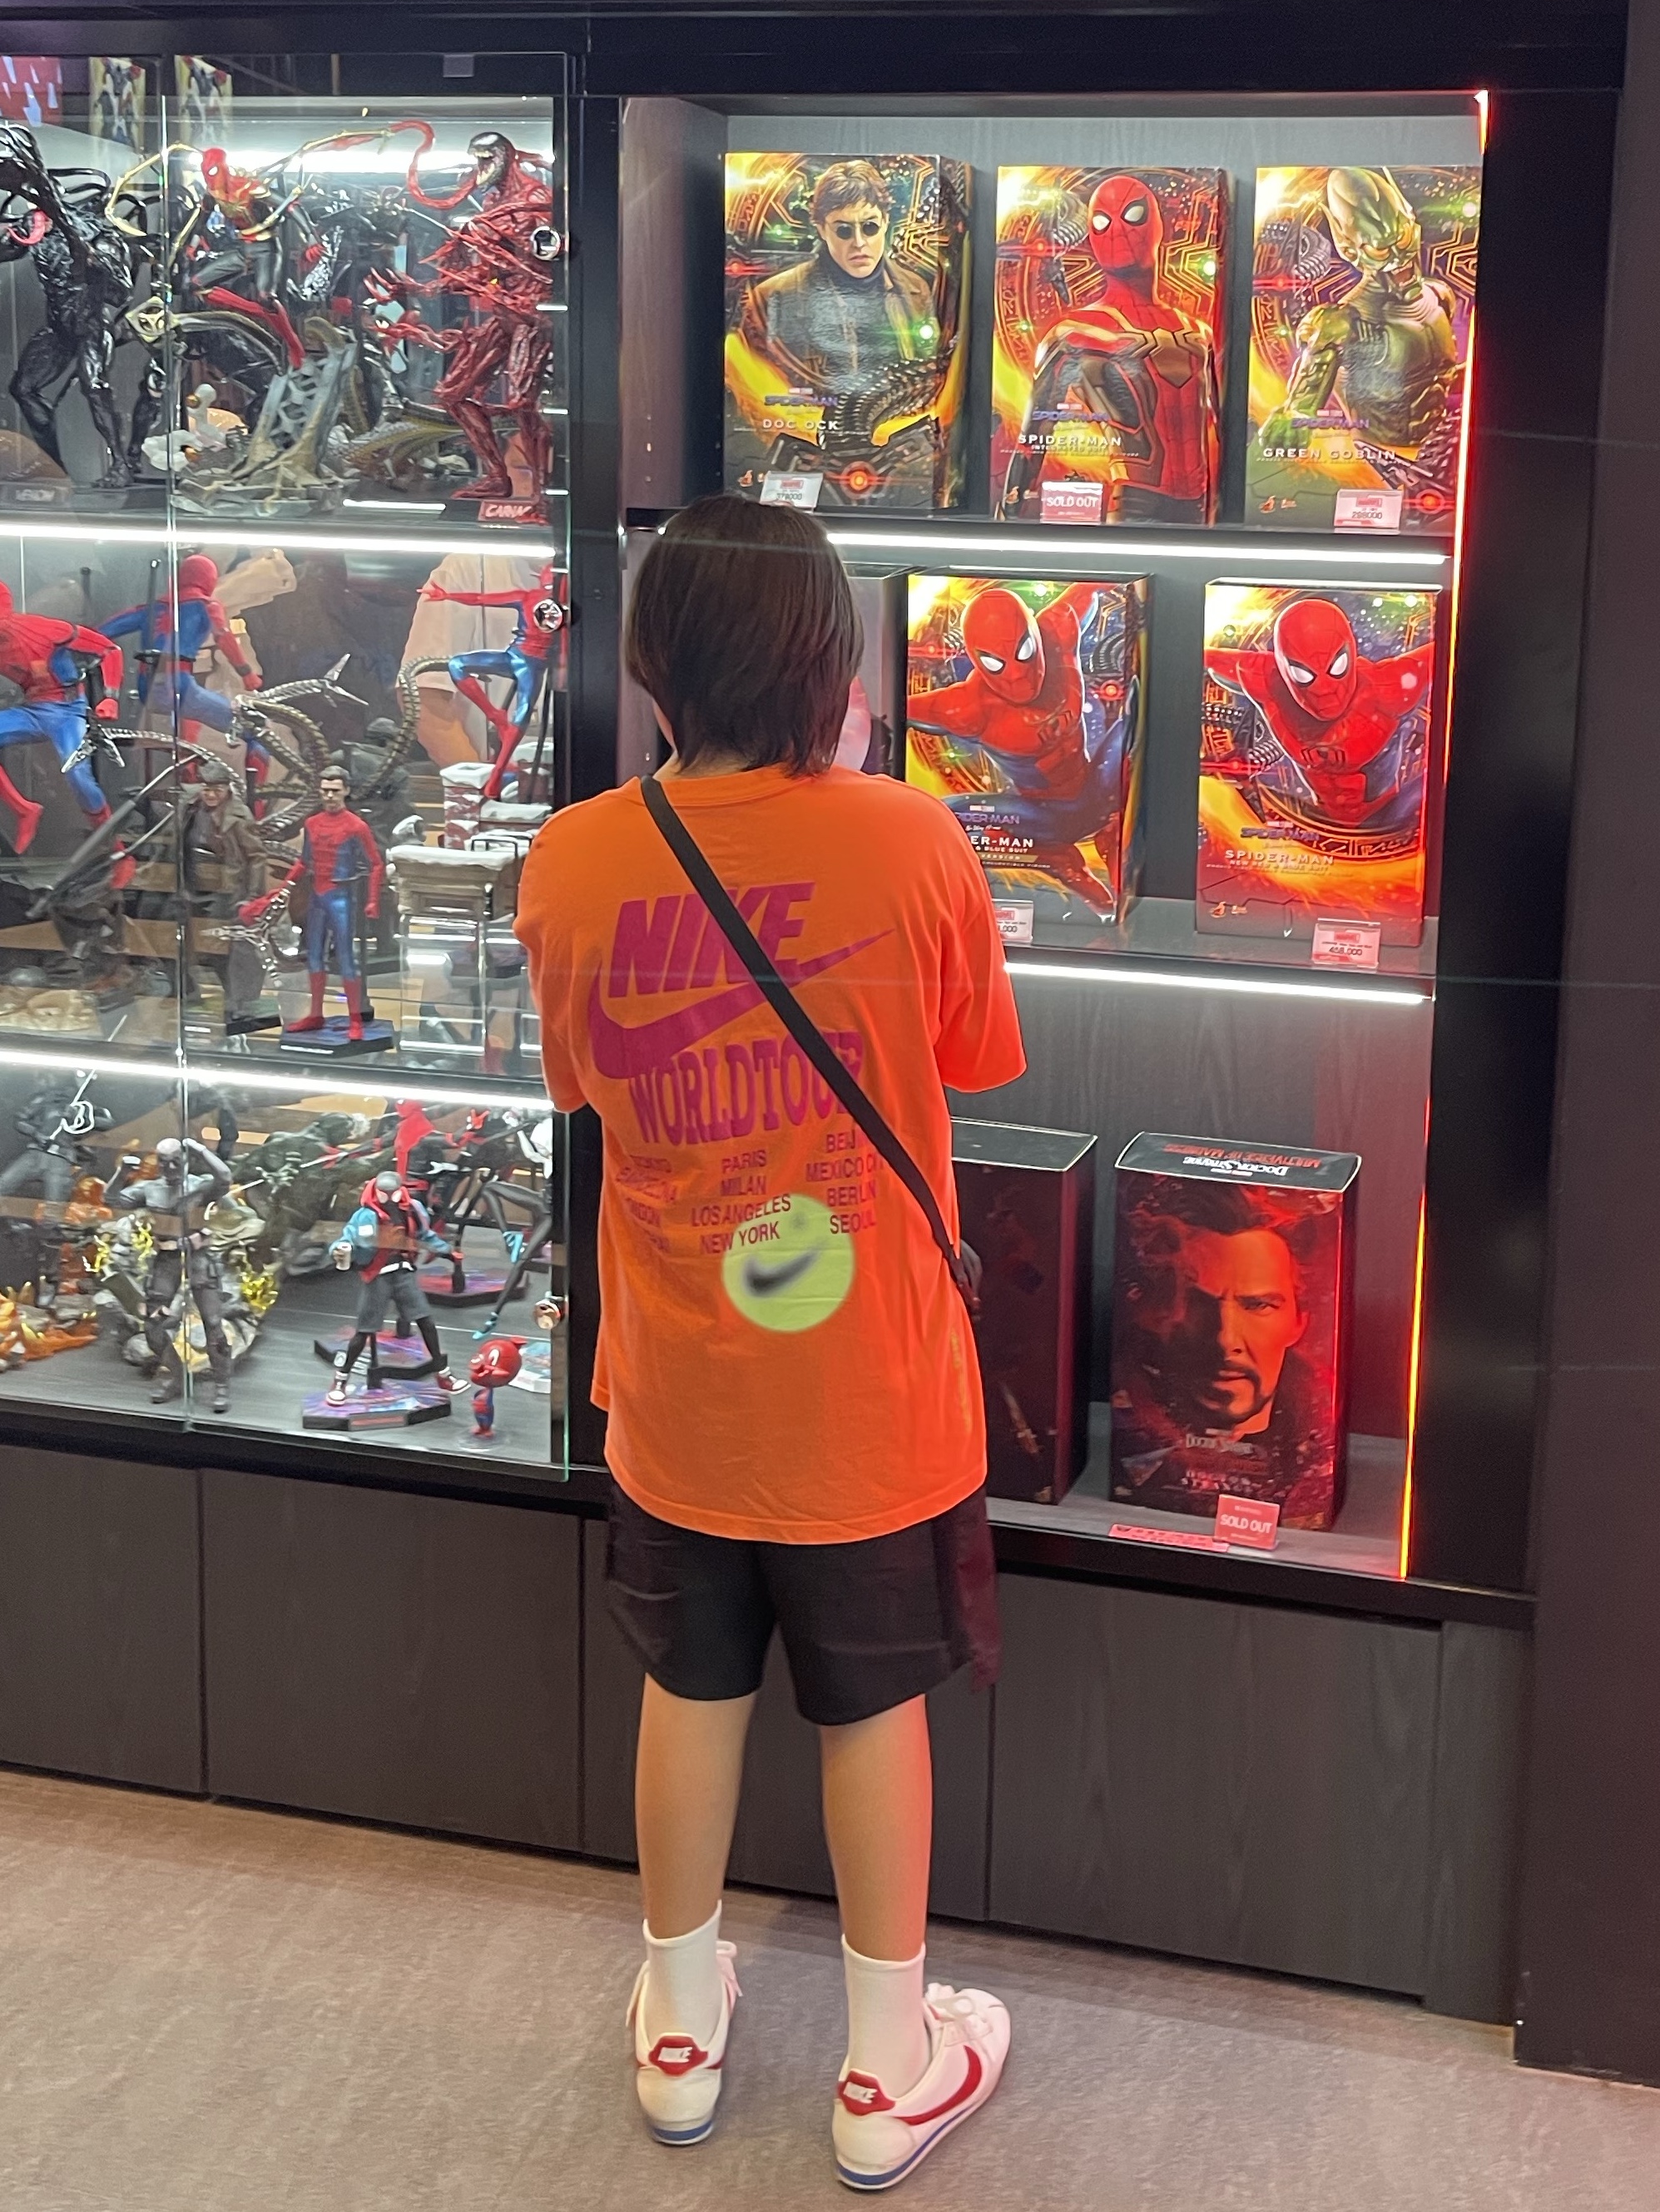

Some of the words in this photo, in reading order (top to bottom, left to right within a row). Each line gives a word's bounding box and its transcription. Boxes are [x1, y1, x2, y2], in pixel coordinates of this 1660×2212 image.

[762, 418, 796, 428] DOC
[805, 420, 839, 430] OCK
[1018, 434, 1122, 446] SPIDER-MAN
[1263, 448, 1321, 458] GREEN
[1330, 450, 1395, 460] GOBLIN
[1046, 496, 1074, 507] SOLD
[1076, 497, 1098, 507] OUT
[970, 835, 1033, 848] ER-MAN
[1225, 849, 1335, 864] SPIDER-MAN
[608, 882, 815, 998] NIKE
[722, 1150, 767, 1173] PARIS
[805, 1157, 863, 1182] MEXICO
[720, 1175, 766, 1196] MILAN
[691, 1206, 720, 1227] LOS
[722, 1193, 790, 1226] ANGELES
[701, 1231, 735, 1254] NEW
[739, 1220, 780, 1246] YORK
[1220, 1514, 1248, 1531] SOLD
[1250, 1519, 1272, 1534] OUT
